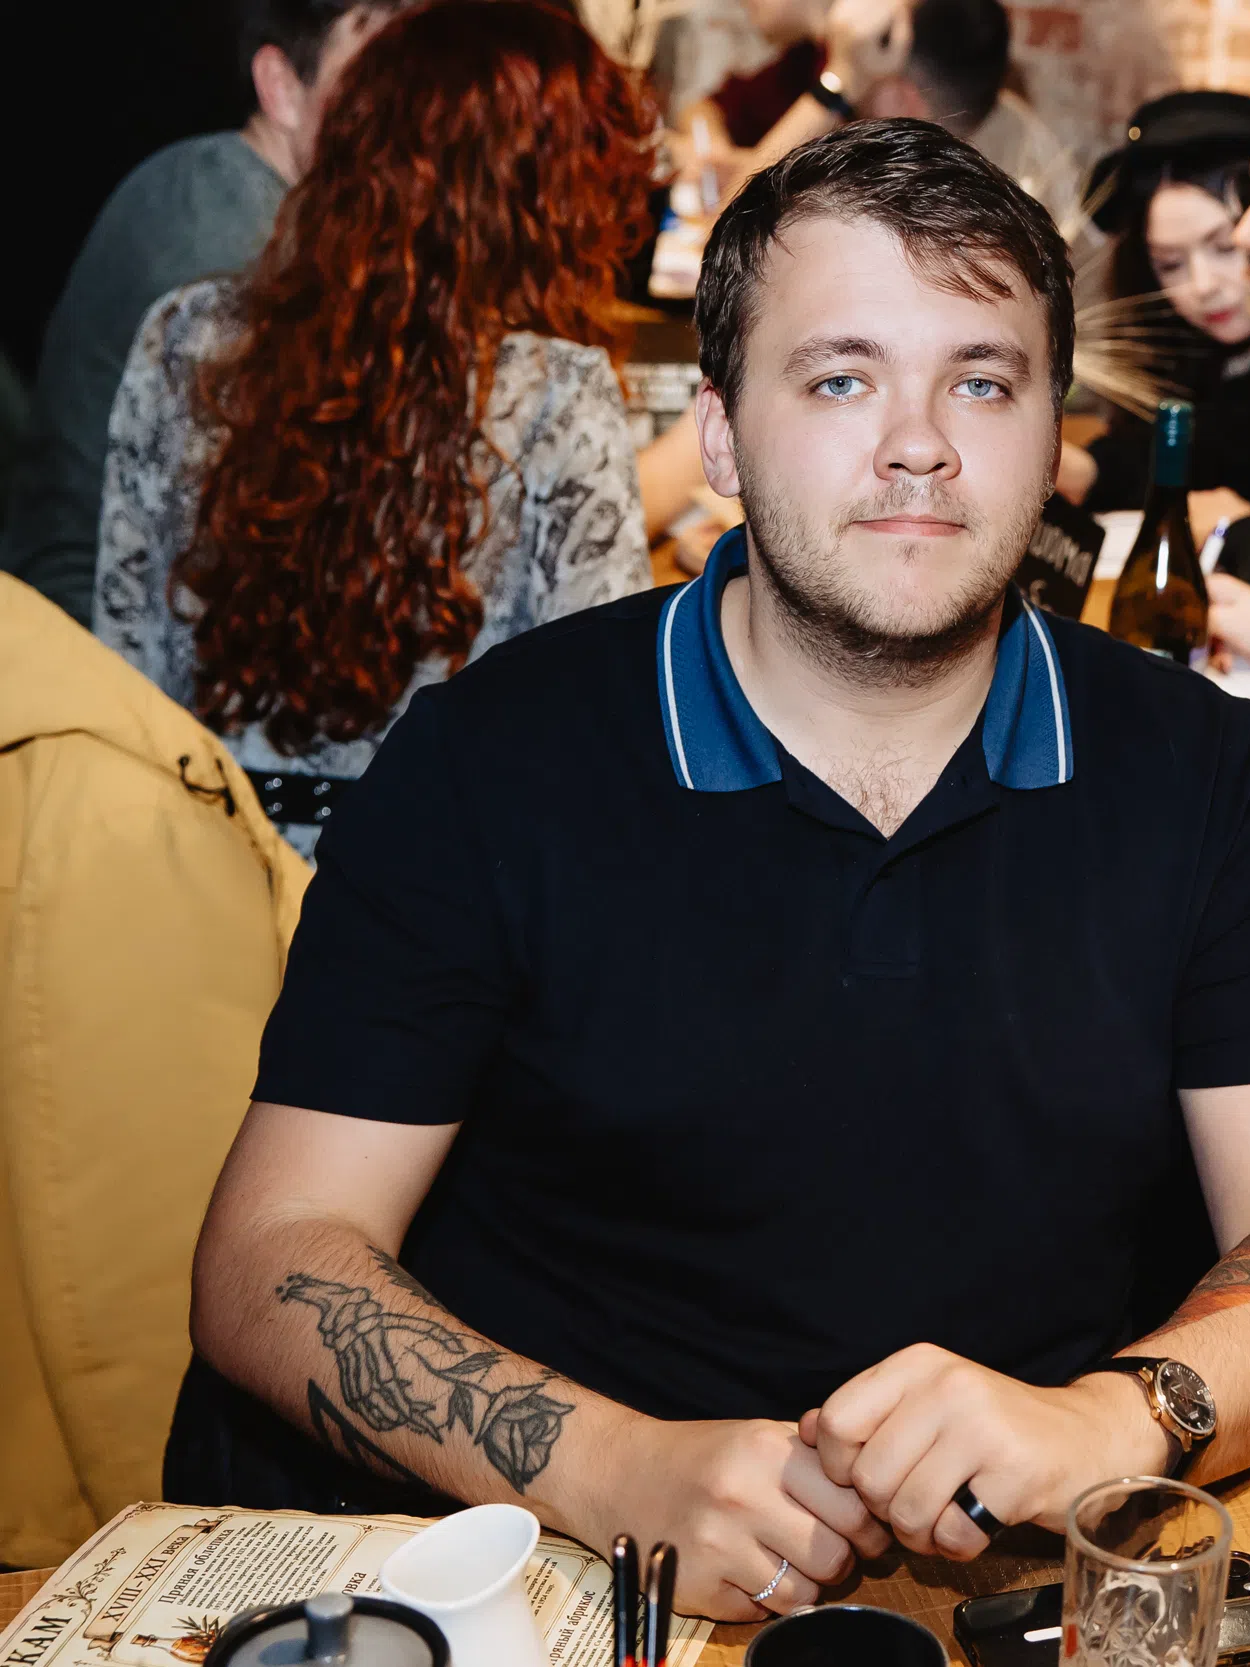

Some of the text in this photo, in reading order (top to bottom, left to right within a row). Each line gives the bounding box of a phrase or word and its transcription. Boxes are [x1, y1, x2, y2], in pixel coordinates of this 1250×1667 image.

[158, 1527, 233, 1603] Пряная облепиха
[162, 1536, 190, 1555] века
[567, 1590, 595, 1625] абрикос
[6, 1617, 70, 1664] КАМ
